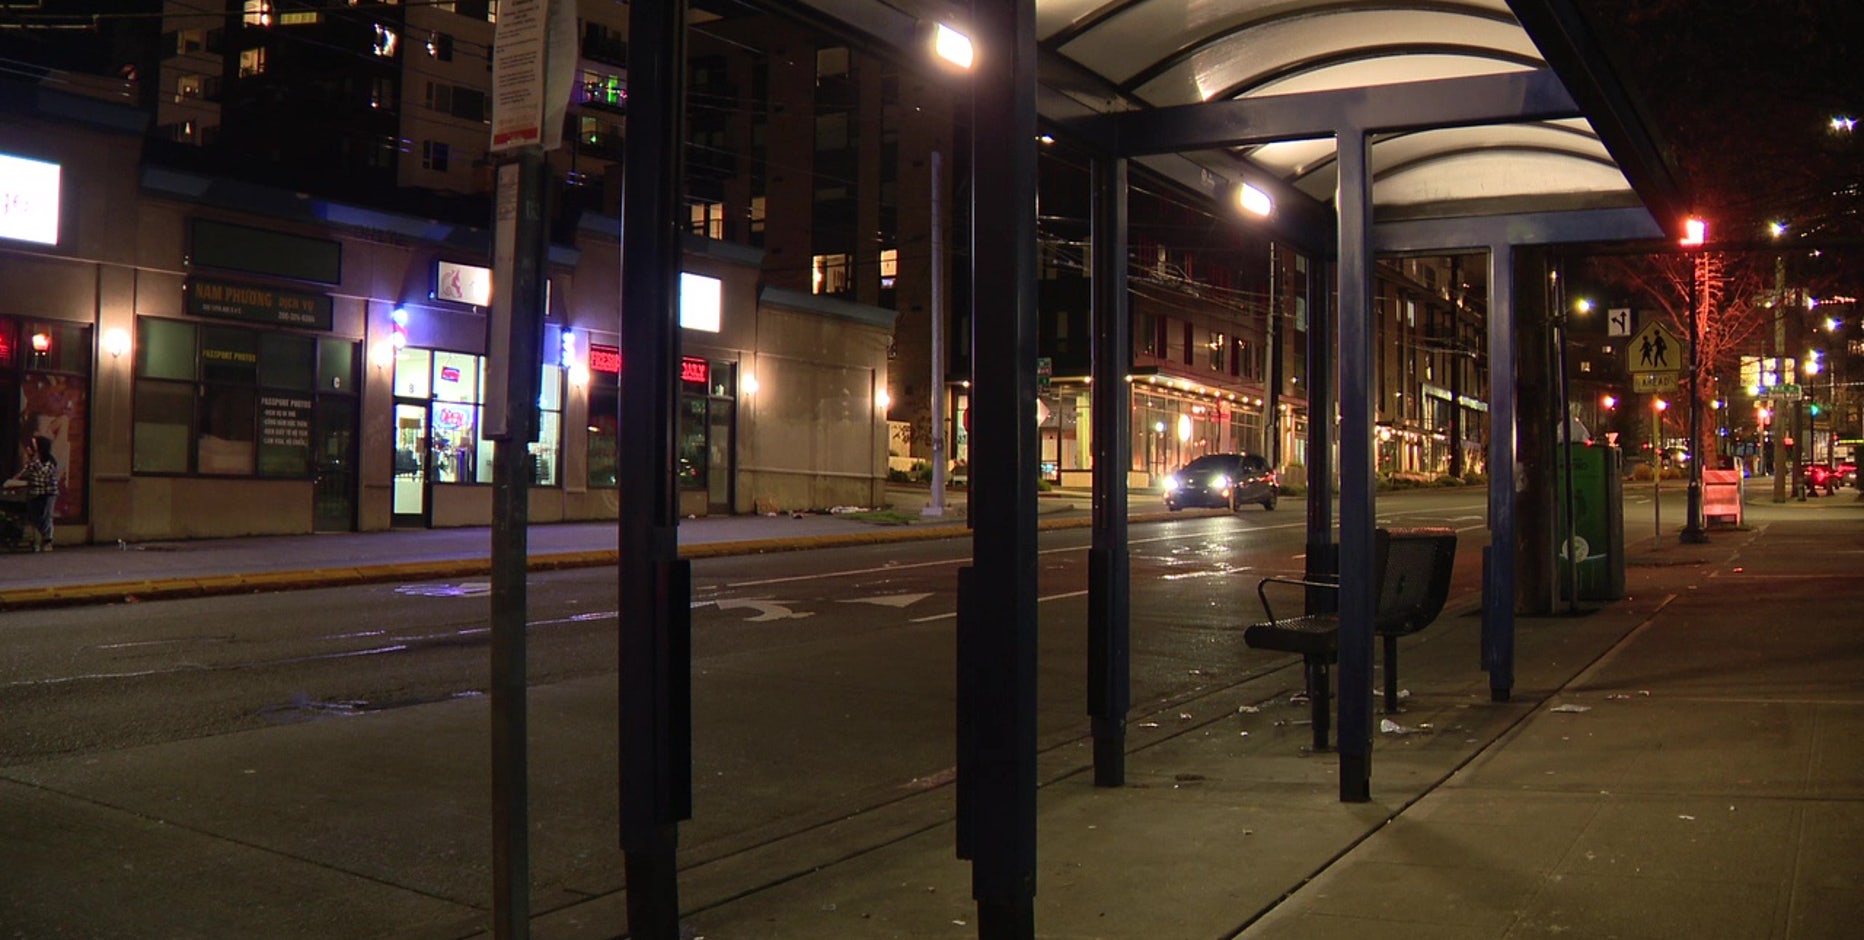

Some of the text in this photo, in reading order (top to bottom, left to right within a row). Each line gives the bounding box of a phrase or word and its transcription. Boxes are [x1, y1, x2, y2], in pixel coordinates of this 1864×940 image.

[195, 282, 224, 301] NAM
[203, 349, 256, 362] PASSPORT PHOTOS
[1641, 376, 1671, 387] AHEAD
[261, 397, 311, 408] PASSPORT PHOTOS
[440, 407, 464, 426] OPEN
